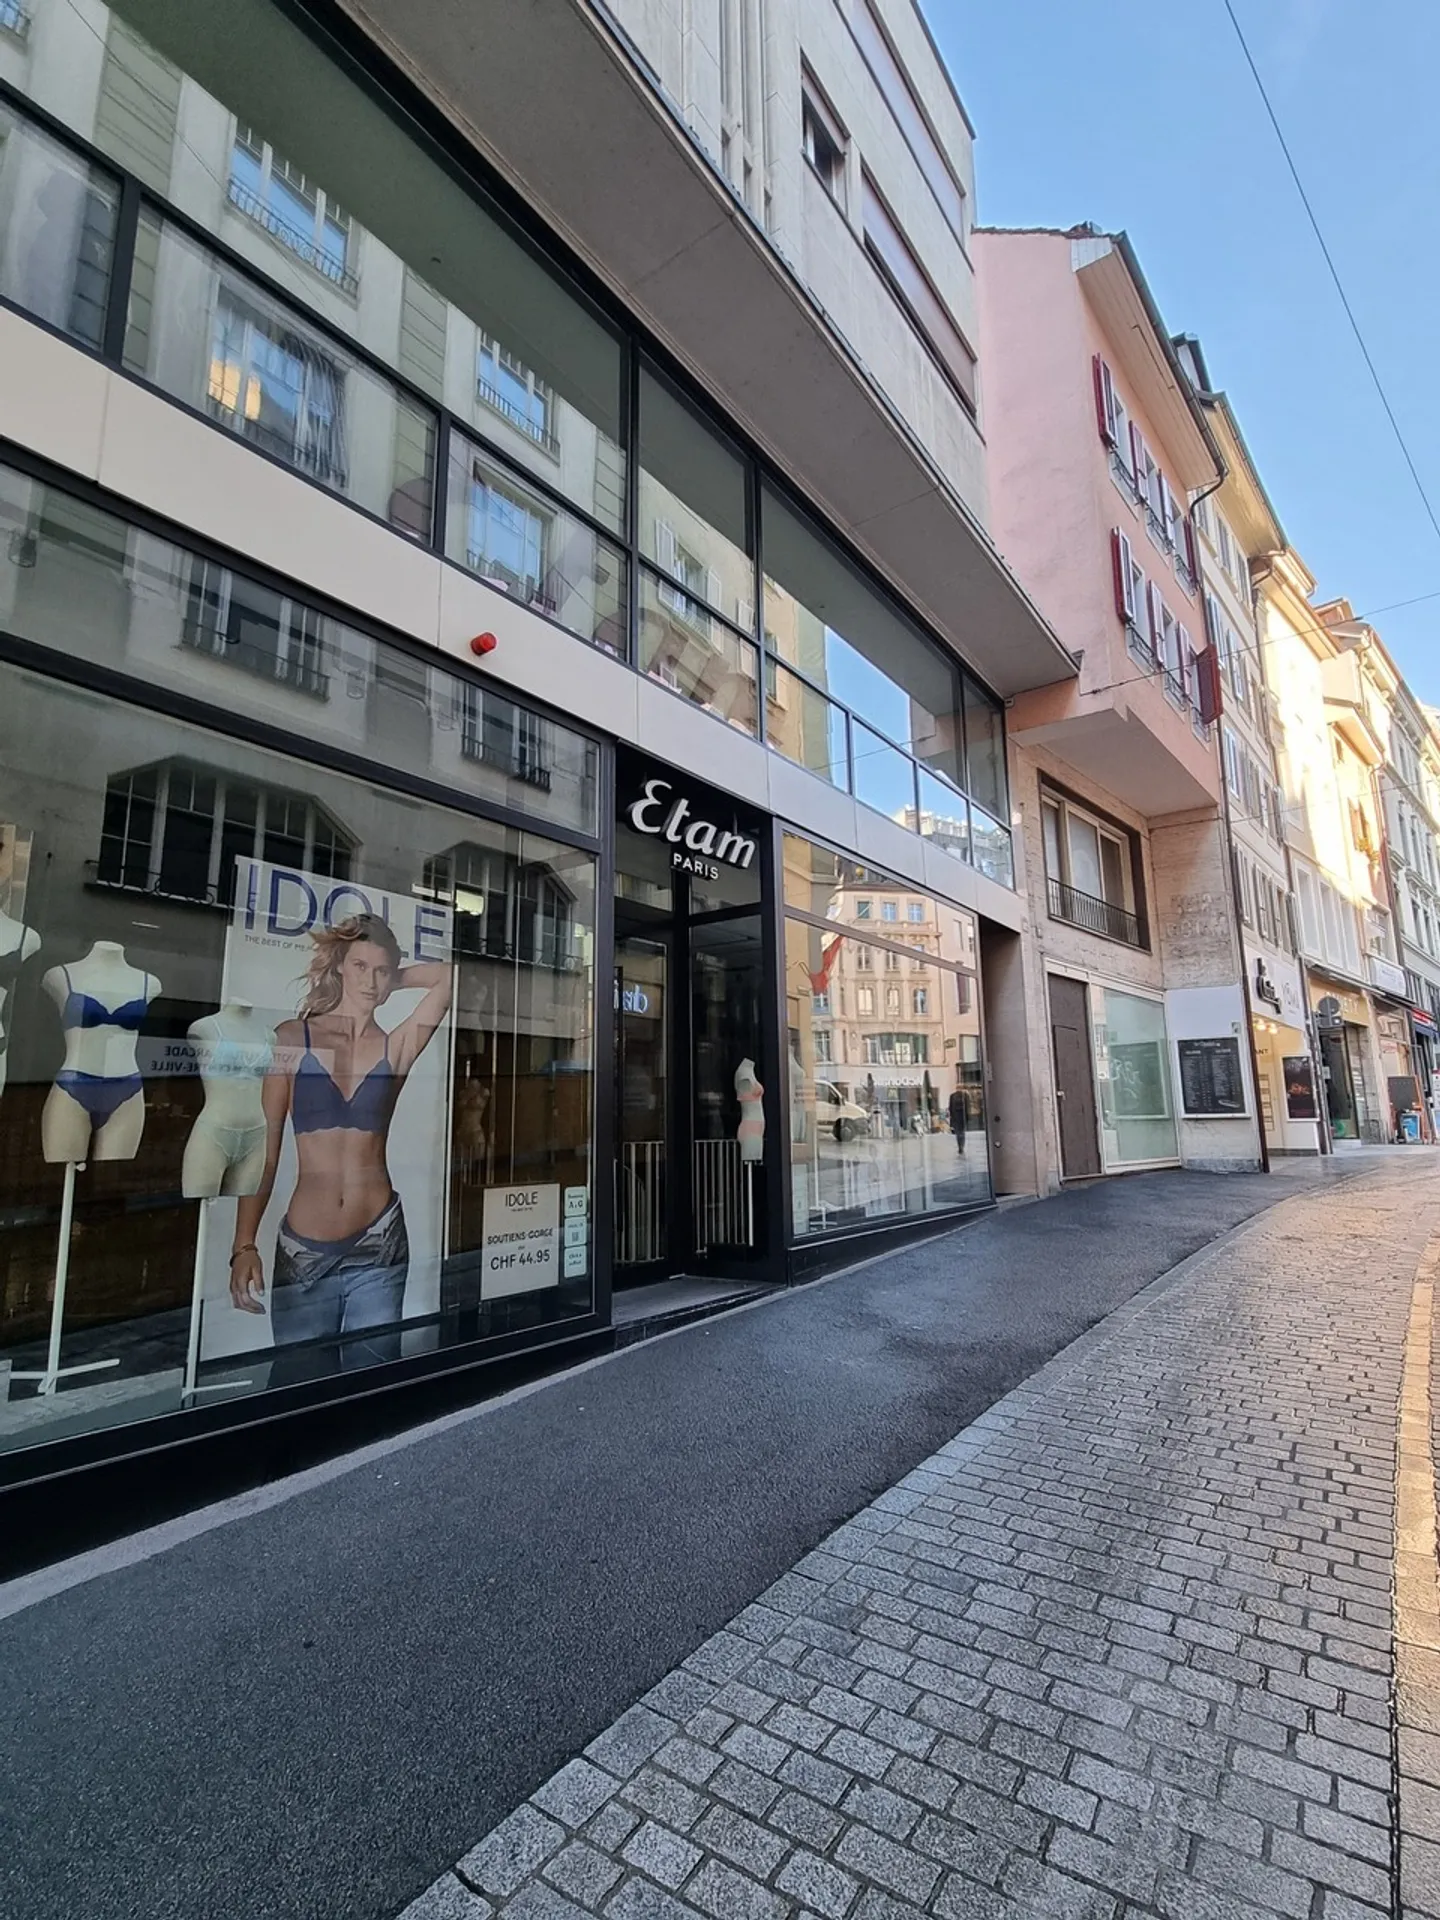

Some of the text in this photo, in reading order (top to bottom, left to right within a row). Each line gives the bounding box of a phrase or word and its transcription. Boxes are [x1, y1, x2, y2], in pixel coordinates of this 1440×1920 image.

[631, 779, 756, 869] Etam
[672, 852, 719, 880] PARIS
[505, 1191, 538, 1208] IDOLE
[490, 1254, 517, 1271] CHF
[518, 1249, 551, 1266] 44.95
